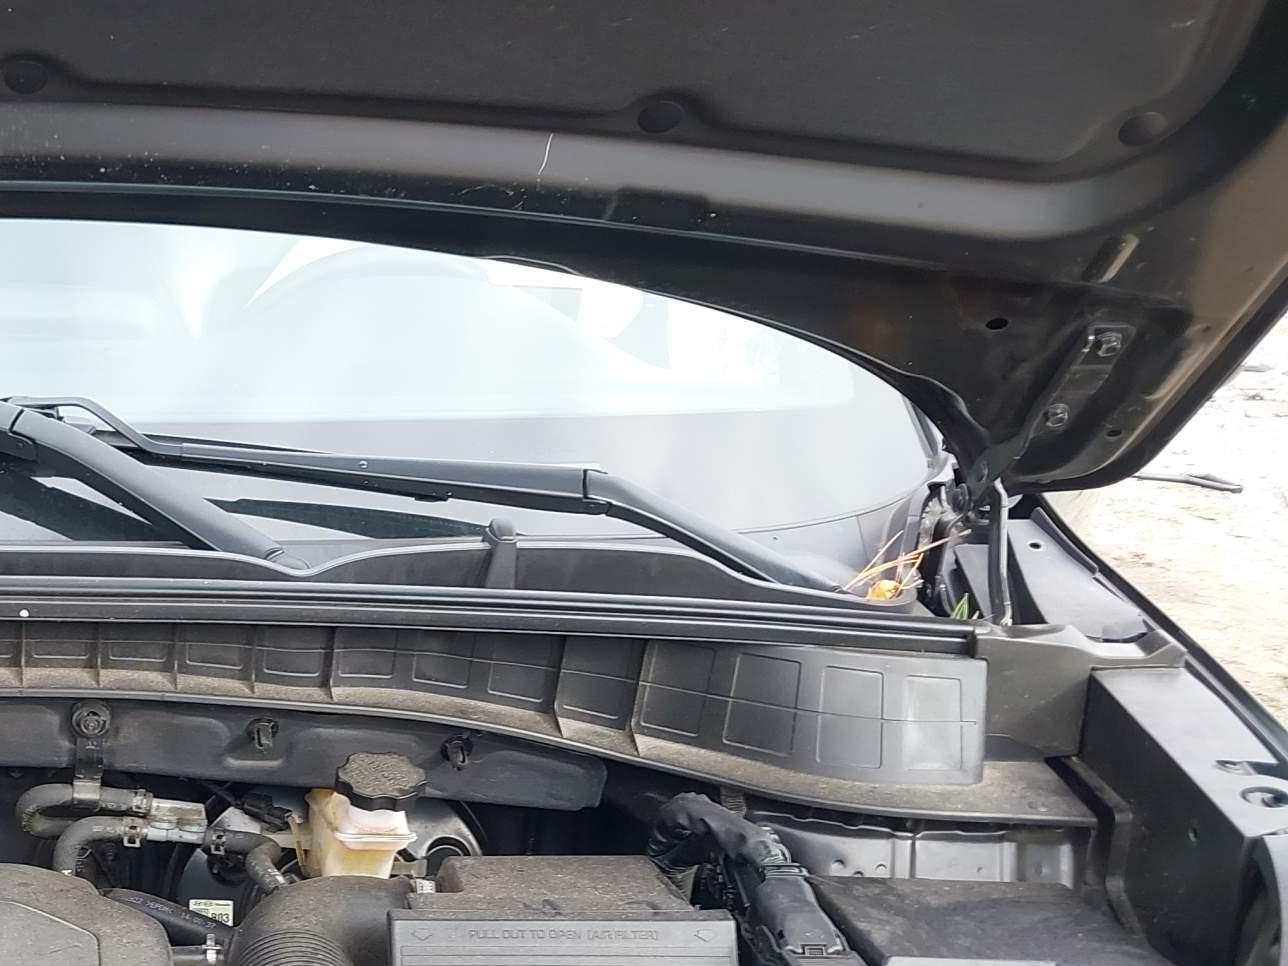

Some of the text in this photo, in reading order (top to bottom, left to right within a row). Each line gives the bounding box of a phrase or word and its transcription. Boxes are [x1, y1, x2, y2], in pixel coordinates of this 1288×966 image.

[469, 929, 500, 940] PULL
[502, 929, 527, 940] OUT
[528, 929, 545, 940] TO
[548, 929, 582, 940] OPEN
